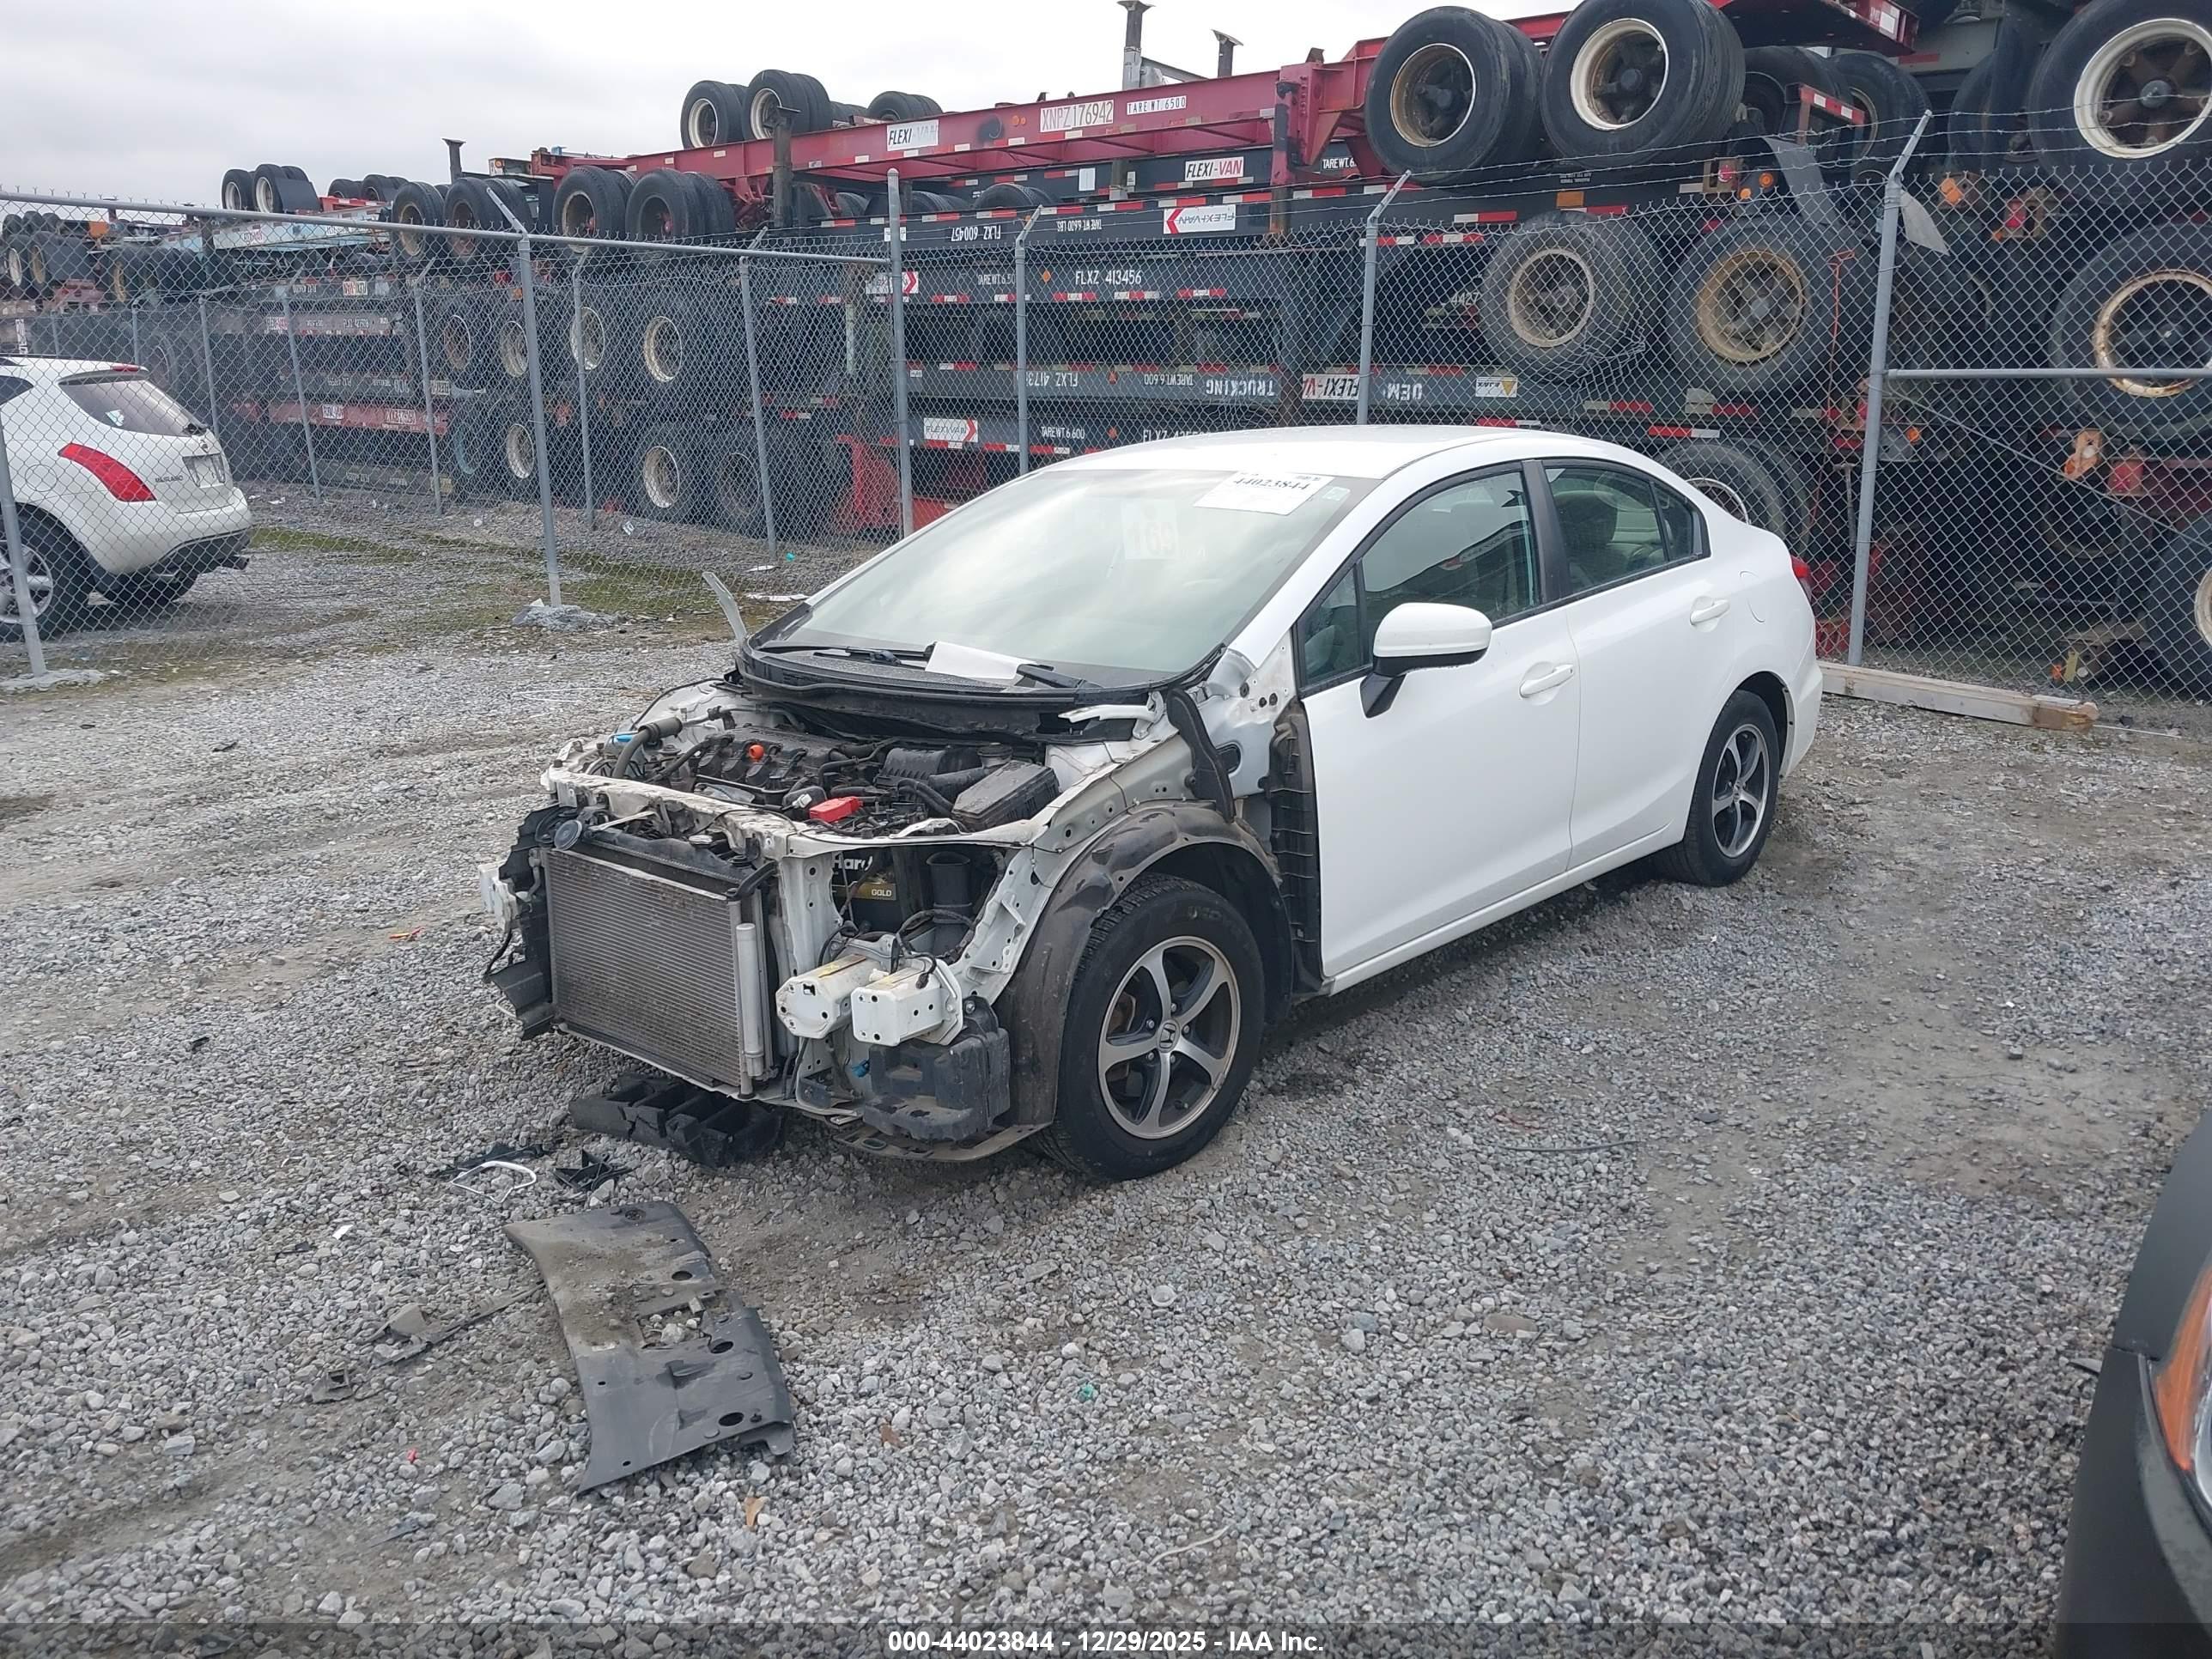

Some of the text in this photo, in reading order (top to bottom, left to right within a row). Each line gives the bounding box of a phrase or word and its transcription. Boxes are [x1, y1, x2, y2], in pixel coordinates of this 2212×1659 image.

[1128, 102, 1147, 113] TARE
[1164, 97, 1186, 109] 6500
[1186, 160, 1243, 179] FLEXI-VAN
[951, 225, 1001, 241] FLXZ 600457
[1075, 270, 1142, 285] FLXZ 413456
[1055, 372, 1079, 387] FLXZ
[1206, 379, 1275, 397] TRUCKING
